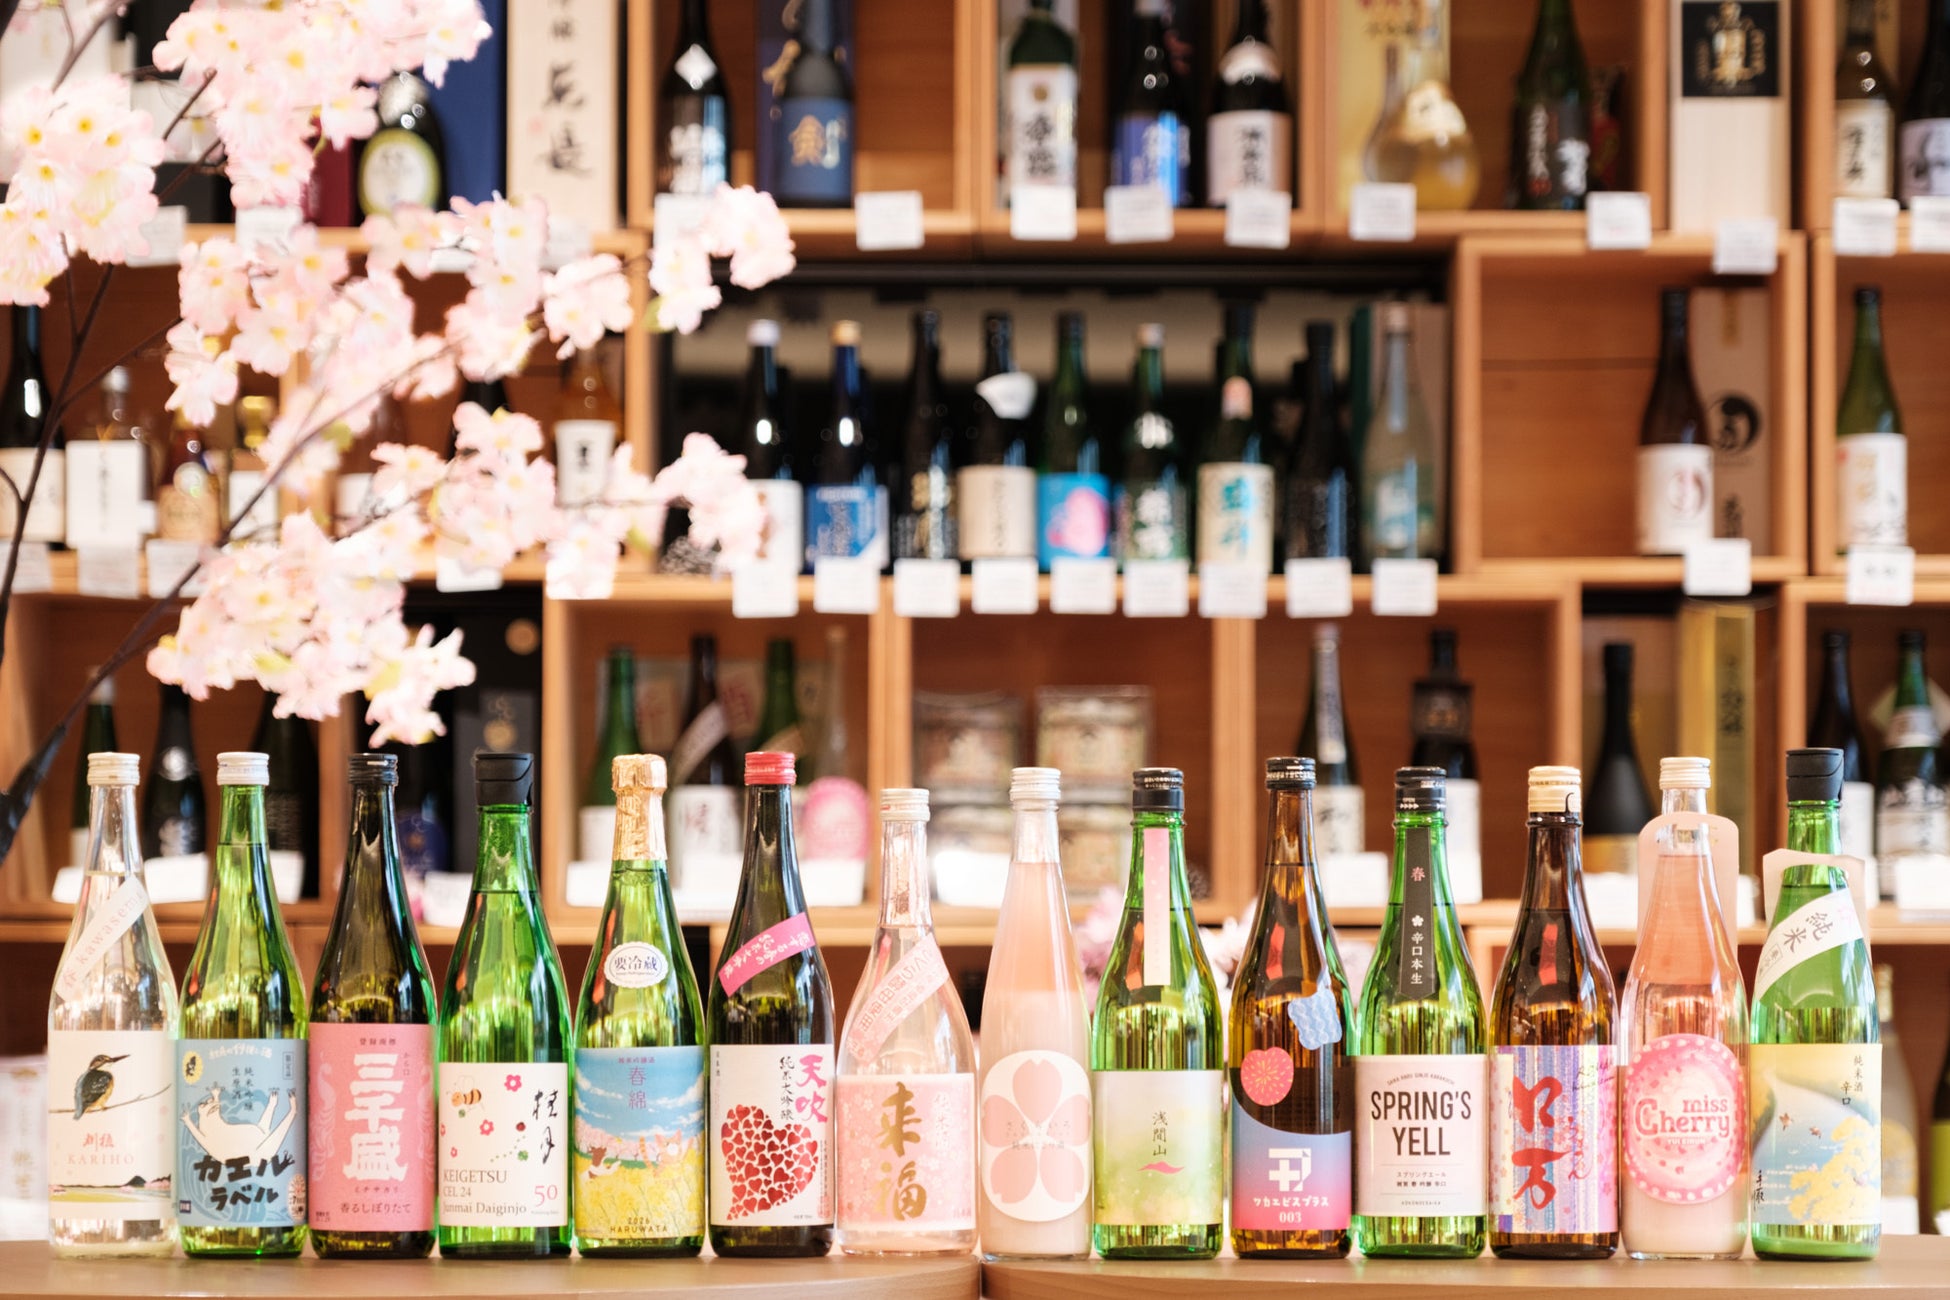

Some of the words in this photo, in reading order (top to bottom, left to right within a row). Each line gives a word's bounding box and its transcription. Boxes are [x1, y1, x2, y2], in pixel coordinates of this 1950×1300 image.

[1410, 866, 1426, 882] 春
[1783, 911, 1834, 953] 純米
[614, 954, 659, 971] 要冷蔵
[1411, 931, 1425, 985] 辛口本生
[628, 1065, 647, 1111] 春綿
[795, 1053, 829, 1124] 天吹
[1840, 1080, 1853, 1105] 辛口
[1371, 1090, 1472, 1121] SPRING'S
[1682, 1094, 1728, 1114] miss
[342, 1052, 409, 1182] 三千盛
[1634, 1097, 1730, 1138] Cherry
[1152, 1110, 1168, 1157] 浅間山
[1392, 1126, 1451, 1156] YELL
[68, 1153, 135, 1165] KARIHO
[193, 1150, 296, 1183] カエル
[443, 1168, 507, 1183] KEIGETSU
[210, 1183, 280, 1212] ラベル
[460, 1186, 472, 1197] 24
[533, 1184, 559, 1208] 50
[1253, 1195, 1329, 1208] ワカエビスプラス
[340, 1202, 412, 1215] 香るしぼりたて
[476, 1202, 528, 1217] Daiginjo
[1279, 1211, 1302, 1224] 003
[609, 1224, 669, 1234] HARUWATA
